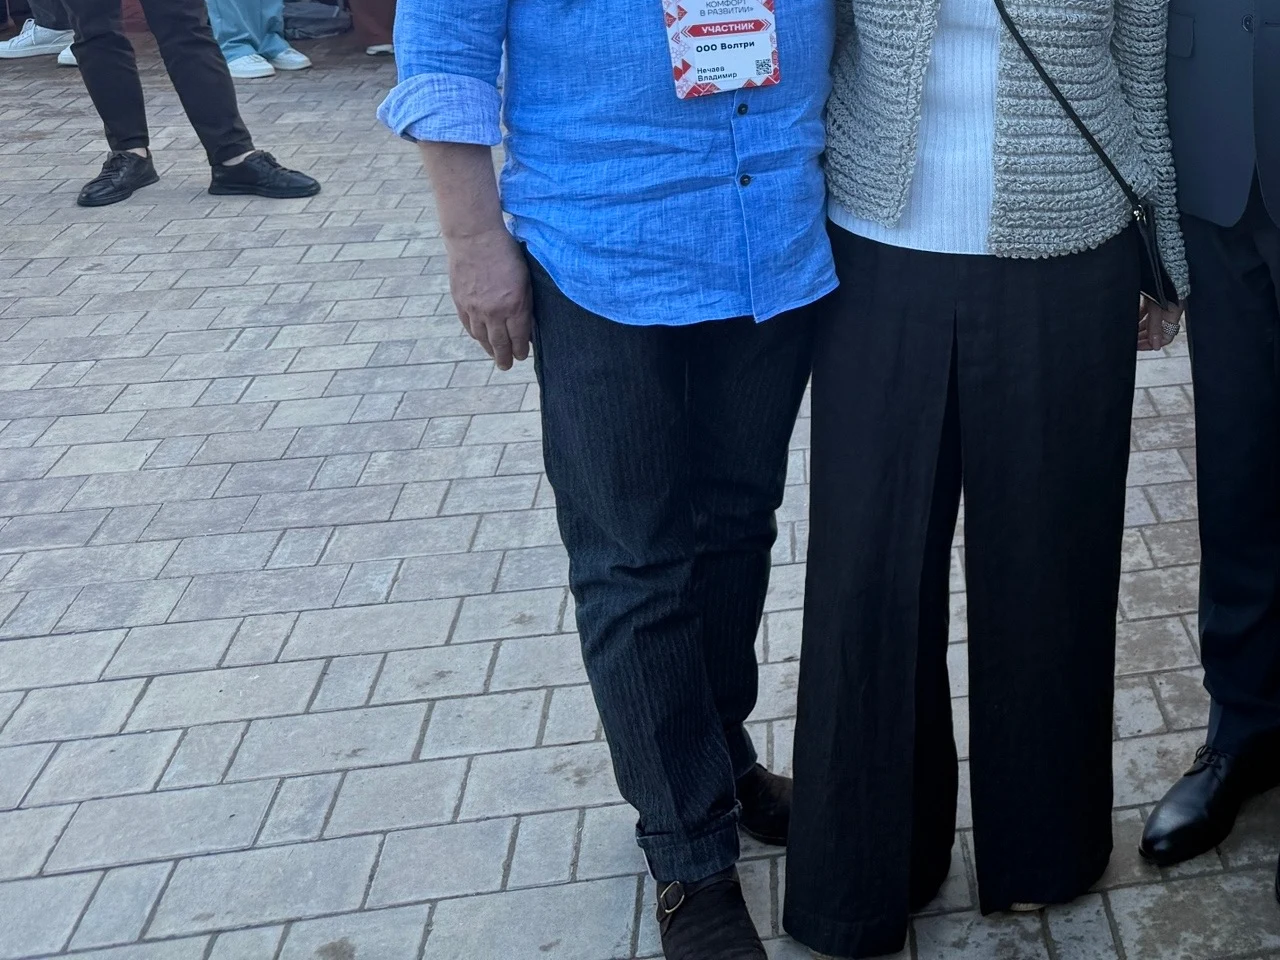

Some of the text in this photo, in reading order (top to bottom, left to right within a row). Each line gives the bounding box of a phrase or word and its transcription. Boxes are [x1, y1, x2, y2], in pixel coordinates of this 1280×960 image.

[700, 6, 754, 17] В РАЗВИТИИ»
[701, 22, 755, 34] УЧАСТНИК
[696, 41, 755, 53] ООО Волтри
[696, 66, 725, 75] Нечаев
[697, 72, 738, 82] Владимир
